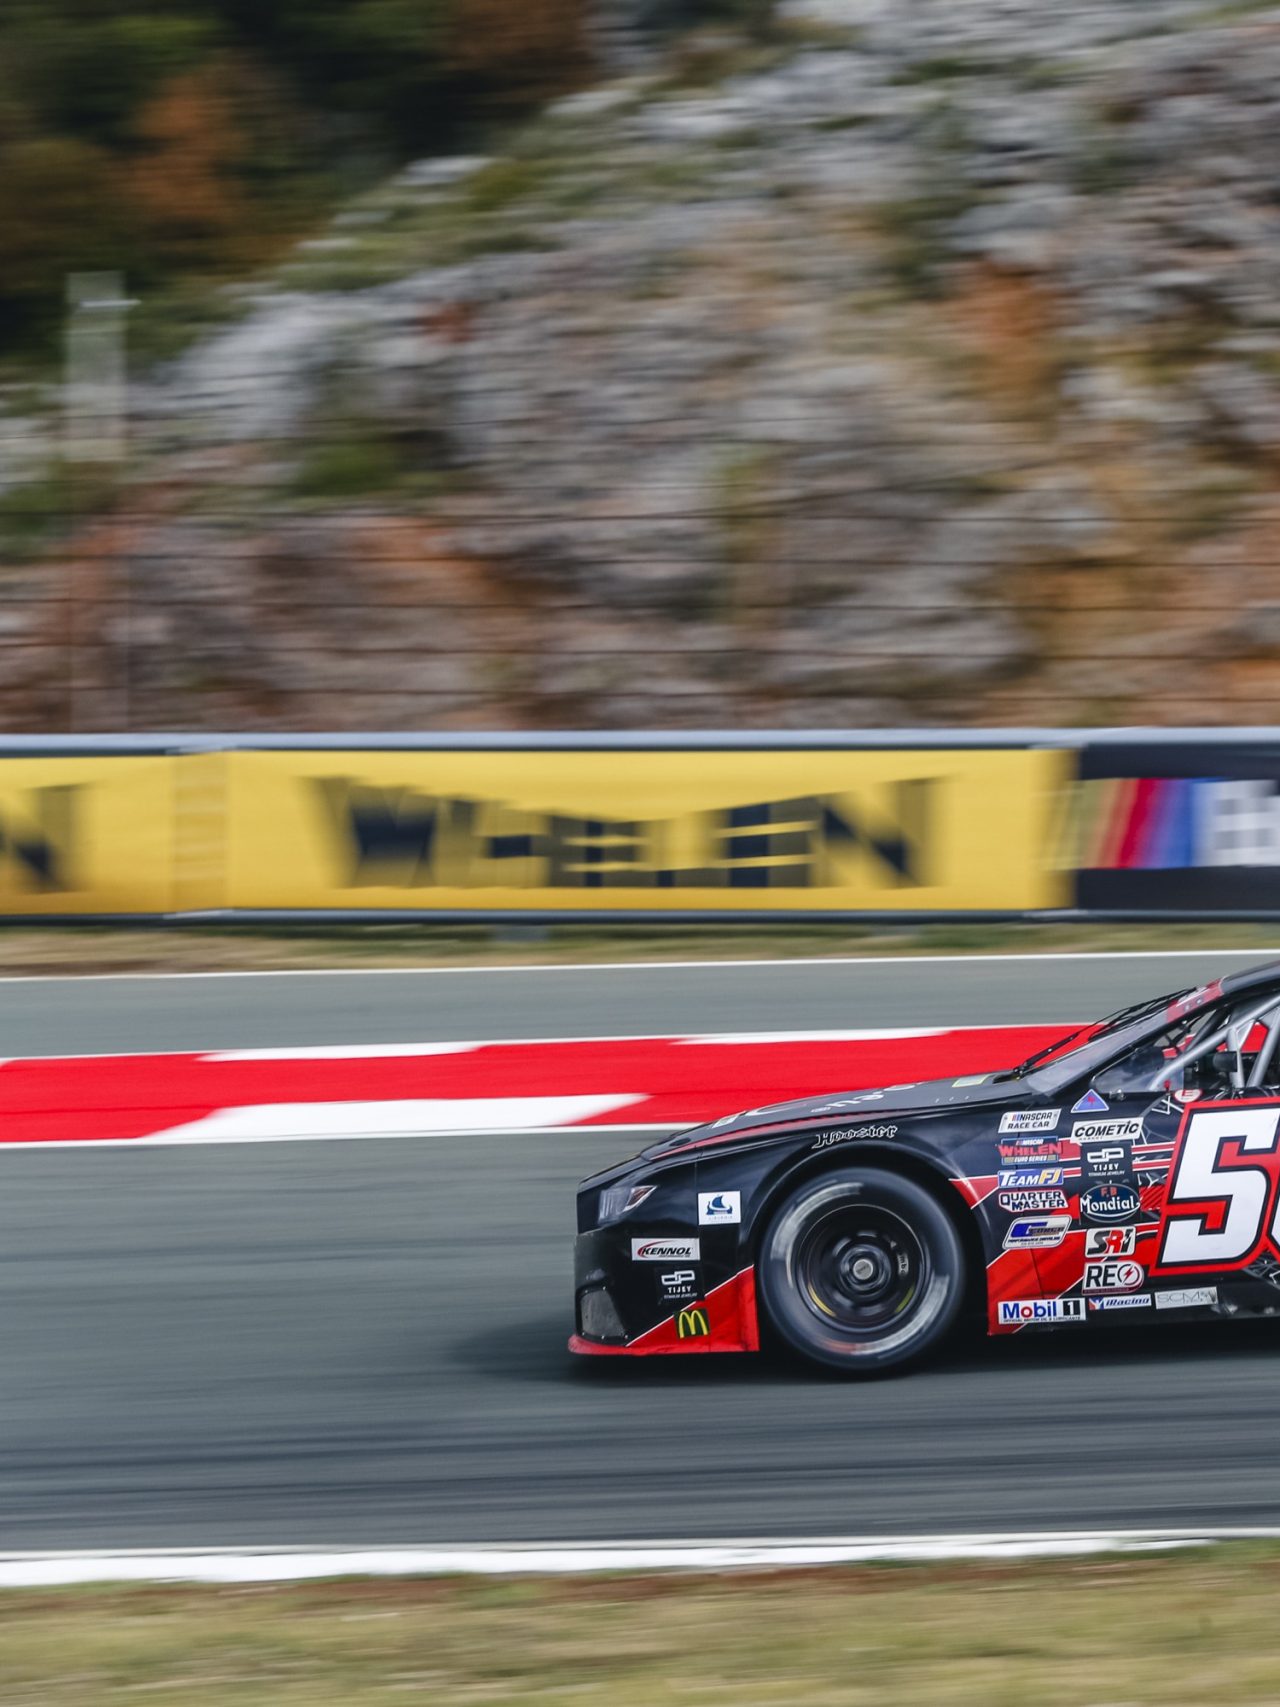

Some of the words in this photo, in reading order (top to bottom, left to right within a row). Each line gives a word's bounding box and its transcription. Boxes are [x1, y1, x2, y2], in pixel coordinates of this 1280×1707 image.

[304, 773, 950, 889] WHELEN
[1020, 1112, 1053, 1121] NASCAR
[1075, 1120, 1140, 1138] COMETIC
[811, 1125, 898, 1150] Hoosier
[998, 1142, 1062, 1156] WHELEN
[1093, 1163, 1119, 1171] TIJEY
[1000, 1191, 1062, 1206] QUARTER
[1012, 1200, 1065, 1211] MASTER
[1080, 1194, 1137, 1214] Mondial
[642, 1246, 693, 1256] KENNOL
[1003, 1301, 1057, 1319] Mobil
